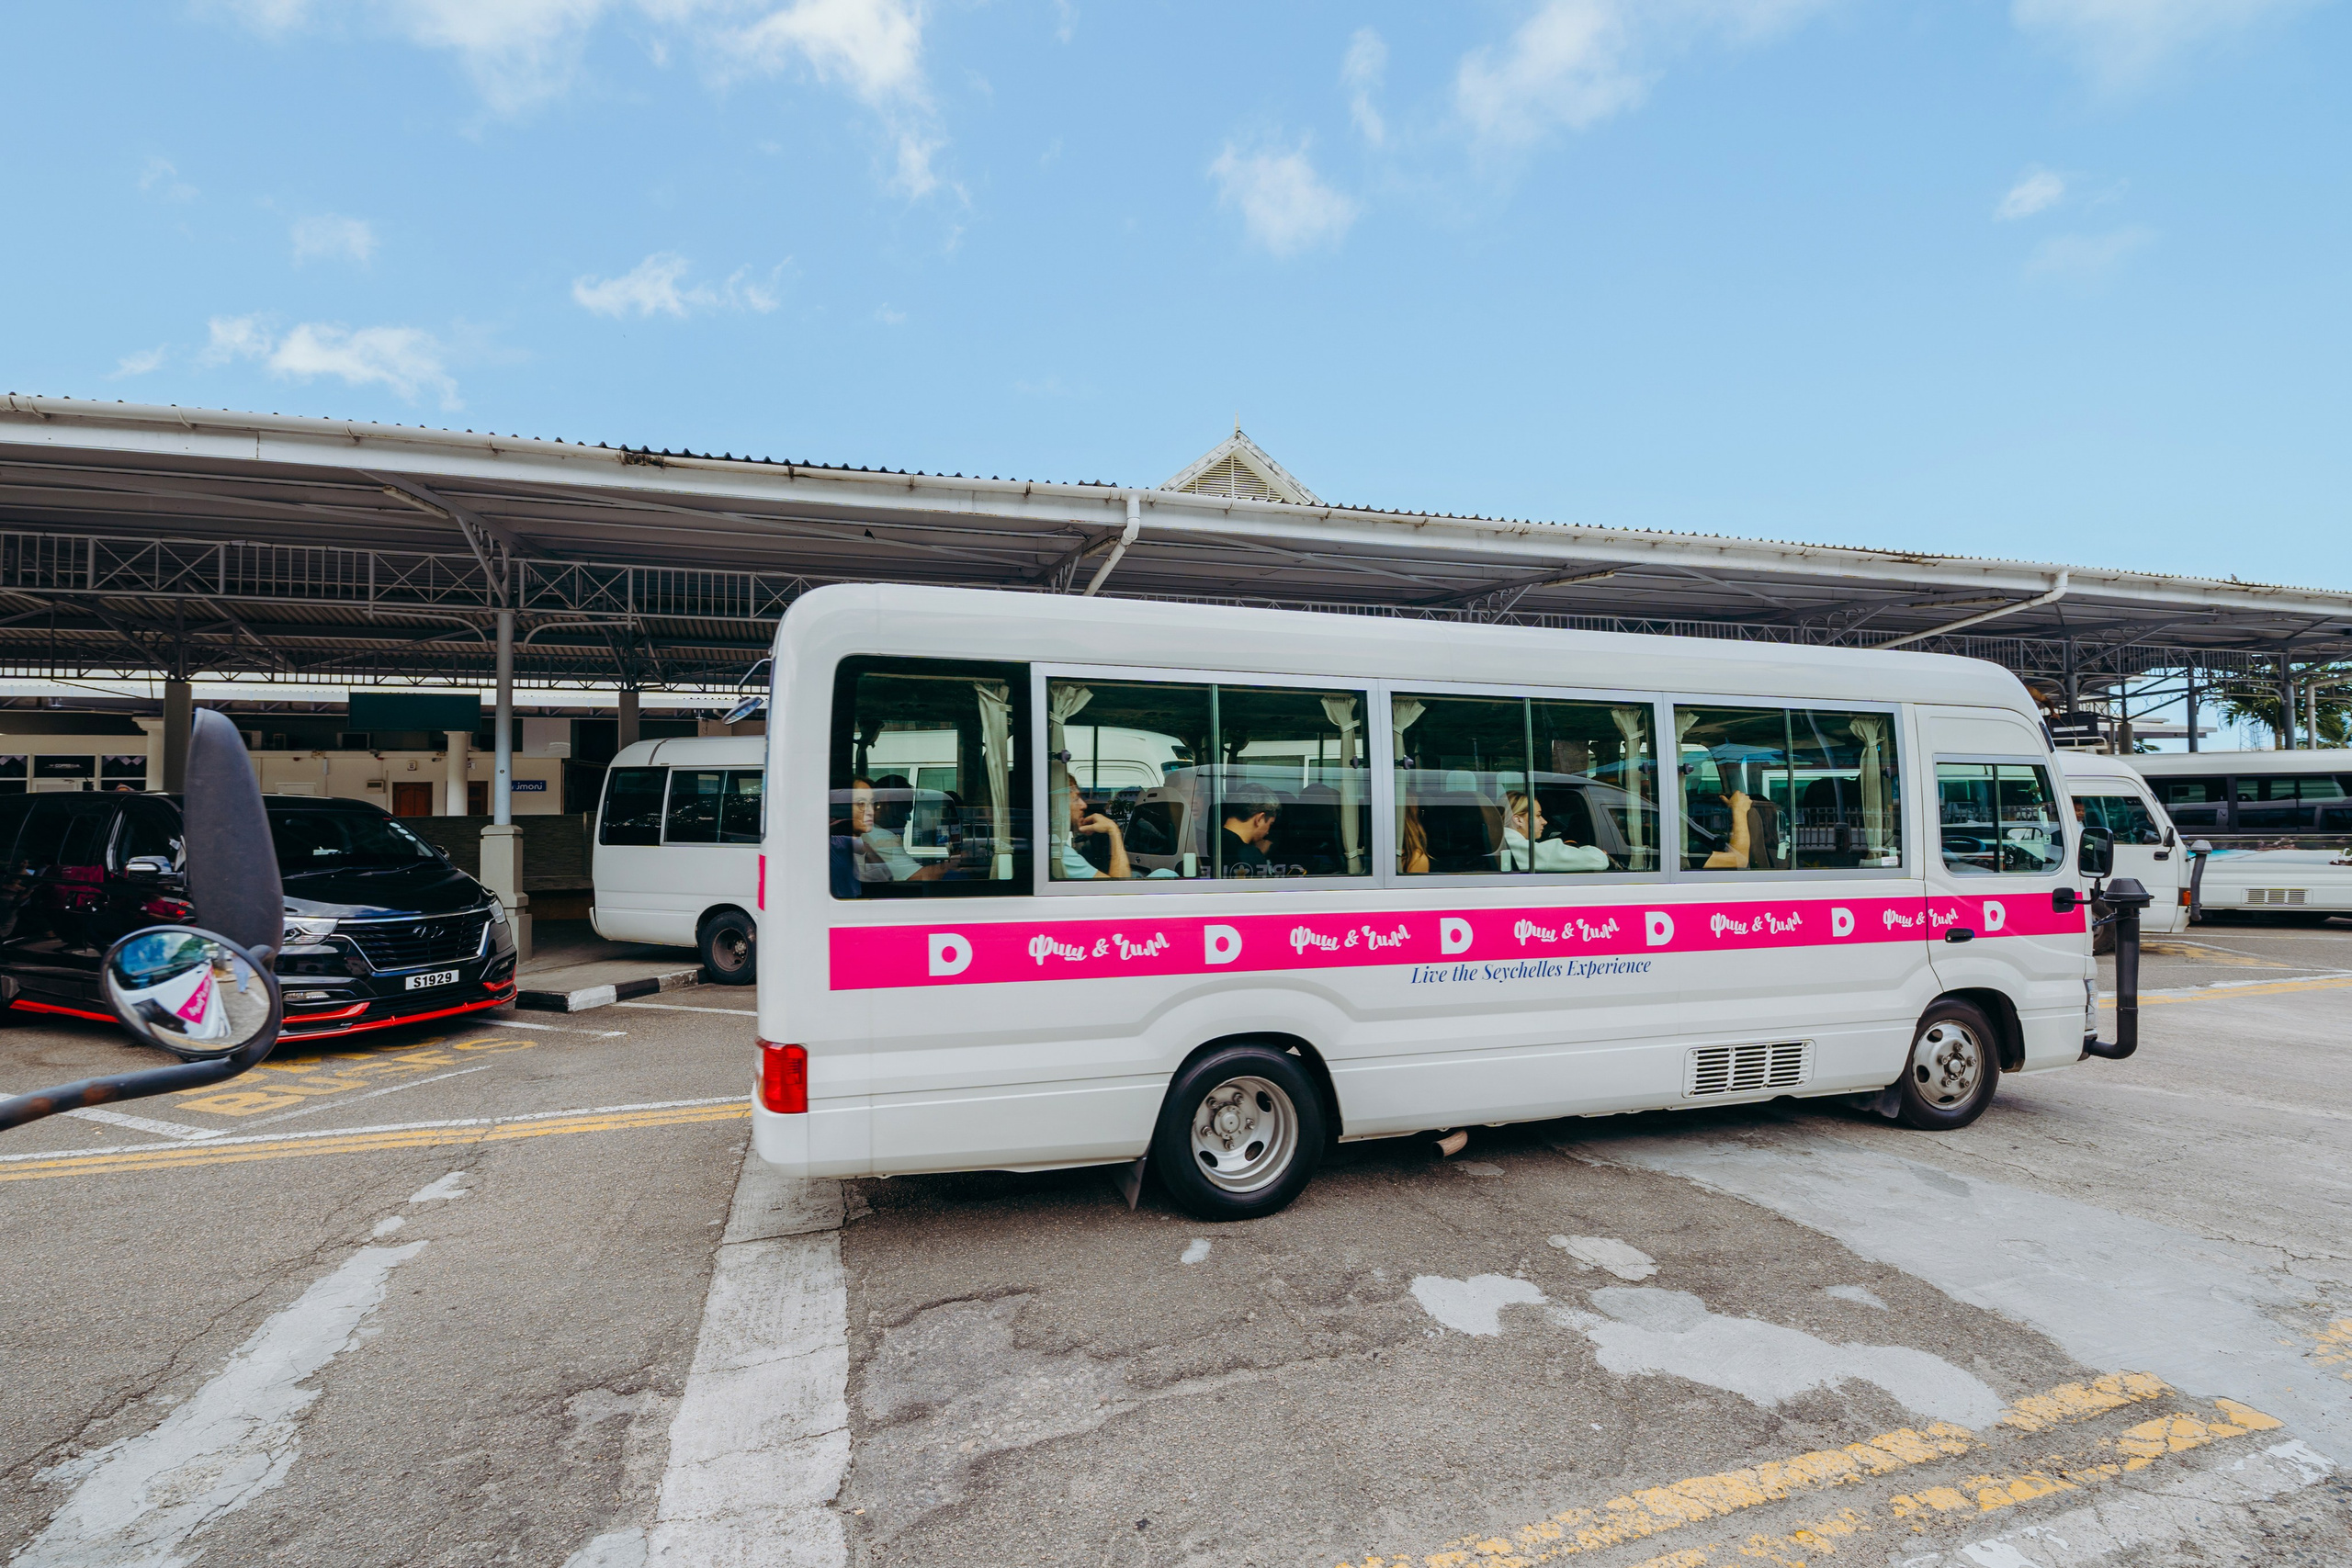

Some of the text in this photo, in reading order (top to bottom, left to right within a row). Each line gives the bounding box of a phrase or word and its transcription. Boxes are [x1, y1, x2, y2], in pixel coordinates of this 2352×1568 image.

[1751, 916, 1763, 932] &
[1916, 911, 1926, 926] &
[1344, 929, 1359, 948] &
[1561, 922, 1575, 940] &
[1091, 938, 1109, 957] &
[413, 972, 452, 987] S1929
[1410, 957, 1652, 984] Live the Seychelles Experience
